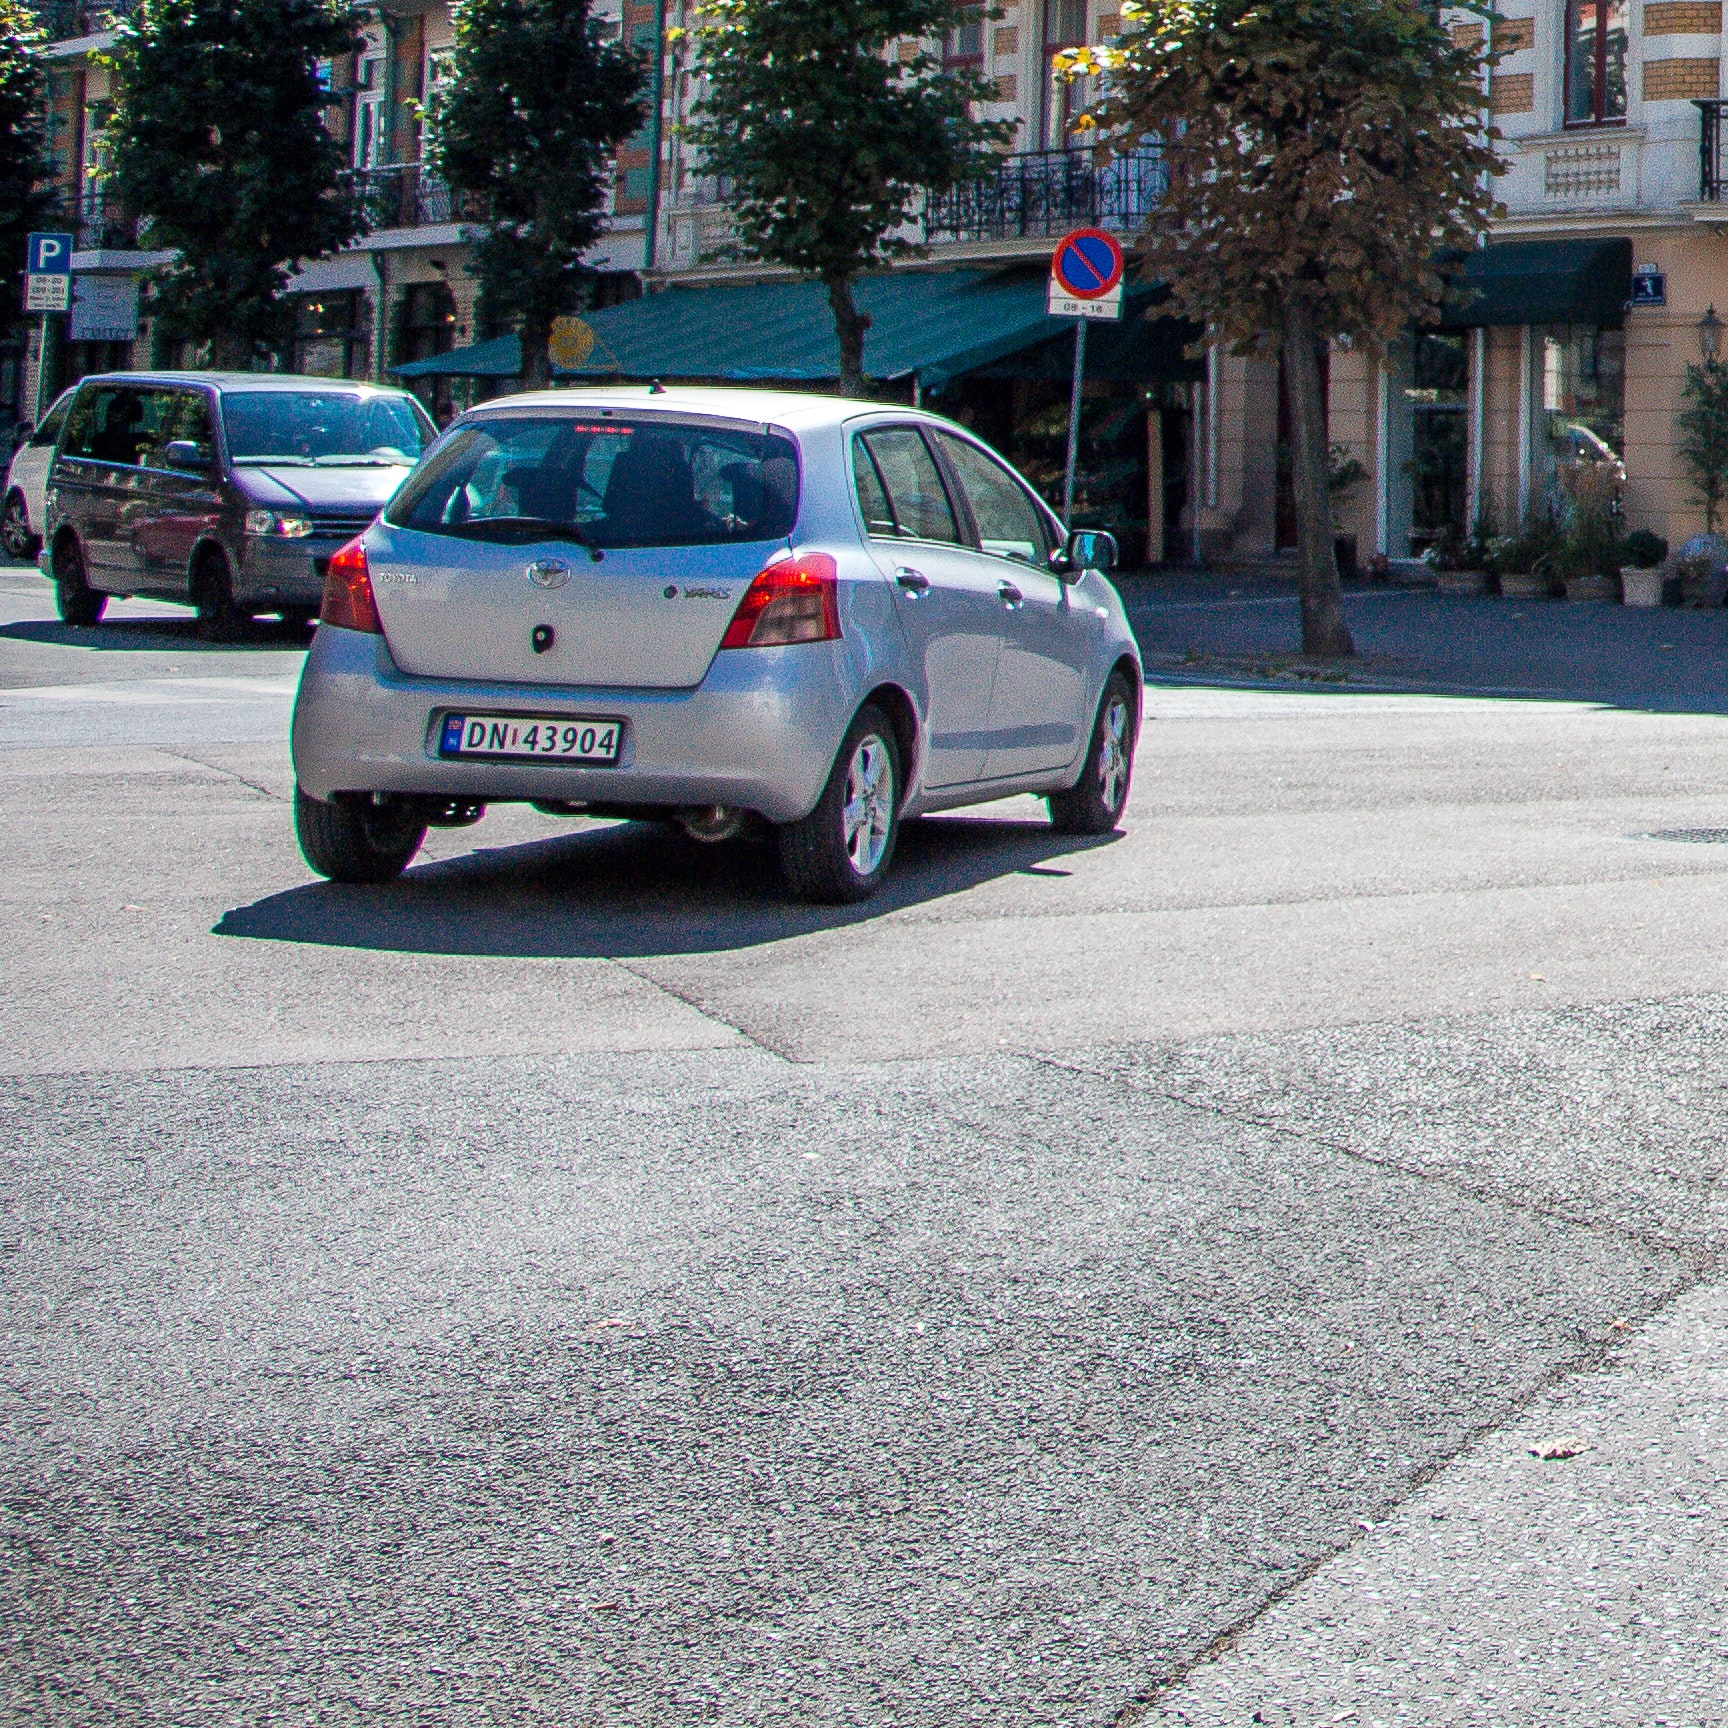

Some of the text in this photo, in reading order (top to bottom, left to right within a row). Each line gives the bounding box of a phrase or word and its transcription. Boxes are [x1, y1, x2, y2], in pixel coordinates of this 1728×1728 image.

[38, 239, 62, 268] P
[467, 721, 616, 755] DN 43904
